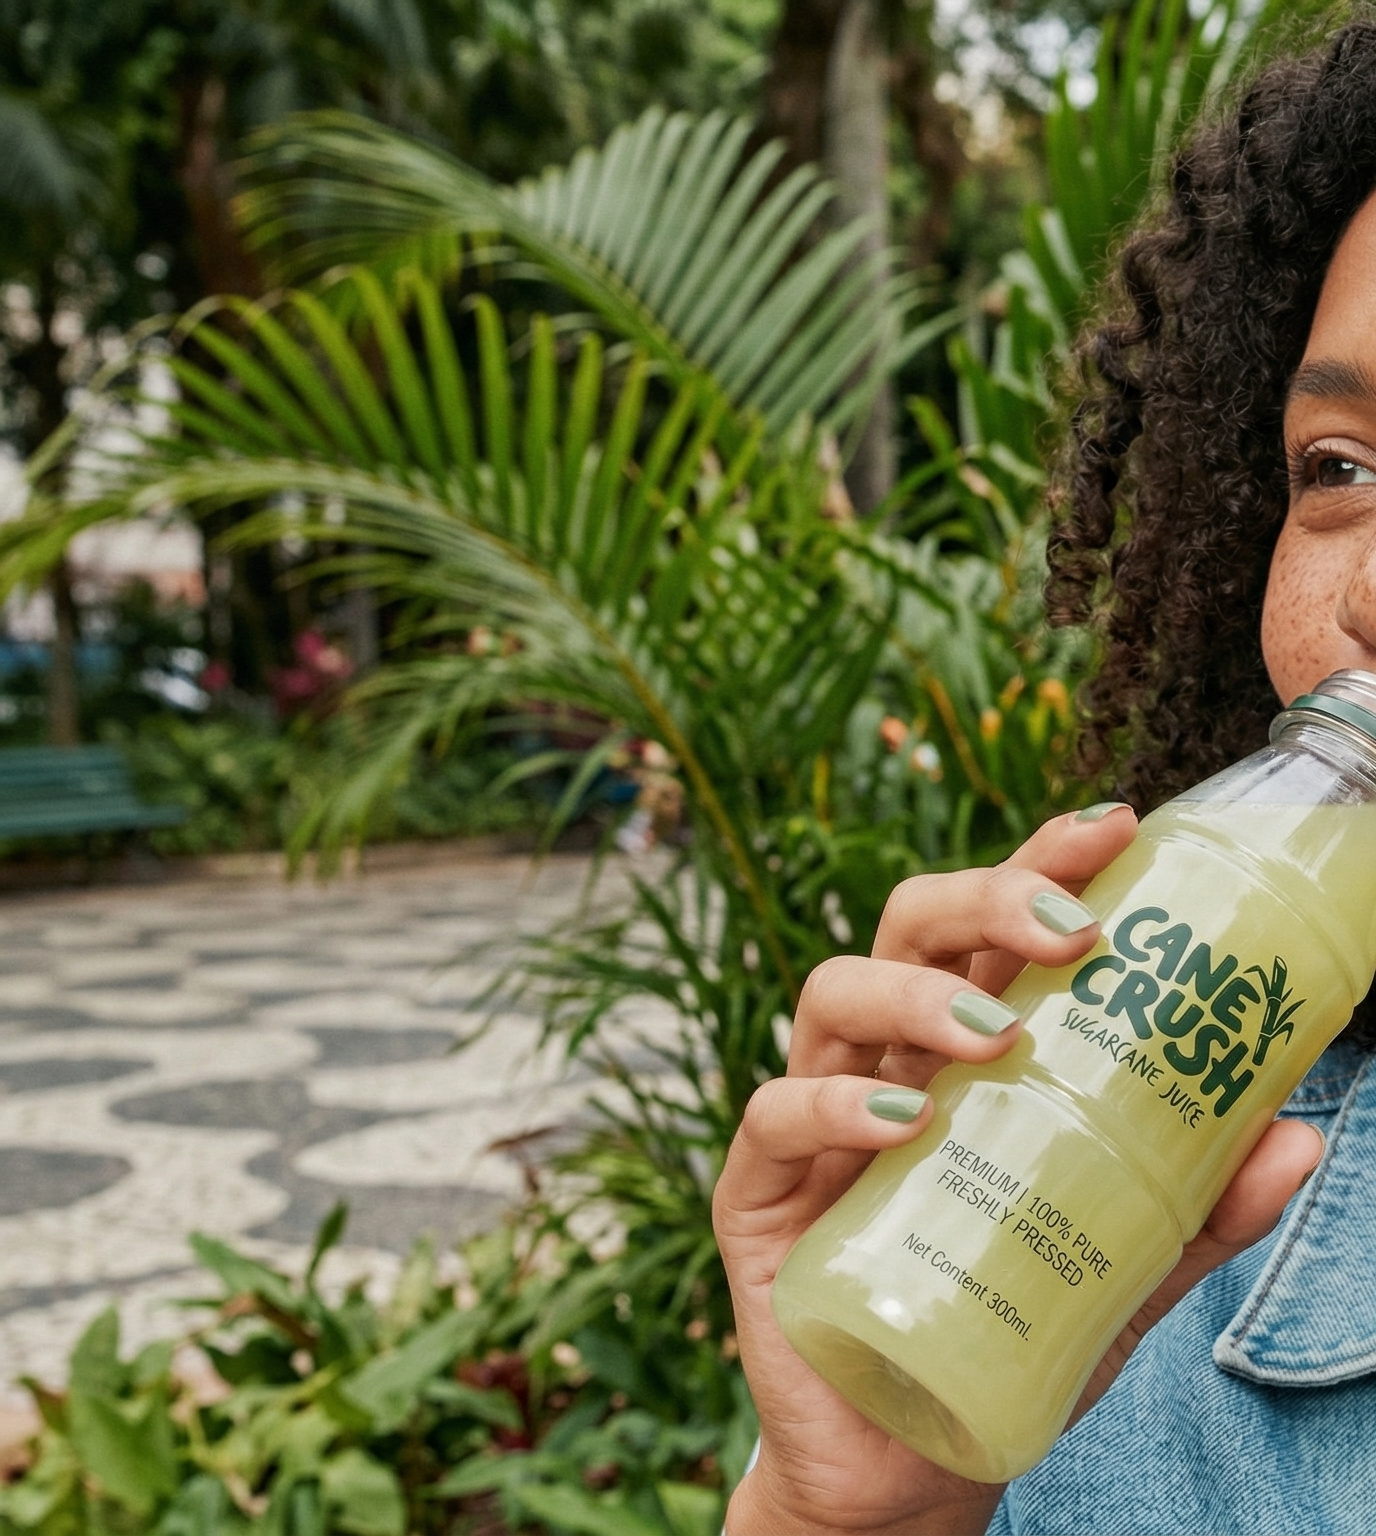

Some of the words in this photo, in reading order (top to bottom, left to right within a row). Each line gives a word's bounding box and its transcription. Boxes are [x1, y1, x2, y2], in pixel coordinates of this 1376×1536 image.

[1113, 906, 1261, 1034] CANE
[1060, 1007, 1164, 1087] SUGARCANE
[1159, 1082, 1205, 1128] JUICE
[1071, 954, 1254, 1117] CRUSH
[937, 1169, 1015, 1225] FRESHLY
[1012, 1218, 1083, 1287] PRESSED
[939, 1140, 1020, 1197] PREMIUM
[1026, 1196, 1073, 1240] 100%
[1072, 1232, 1112, 1280] PURE
[902, 1232, 931, 1259] Net
[930, 1250, 988, 1301] Content
[986, 1292, 1032, 1342] 300ml.
